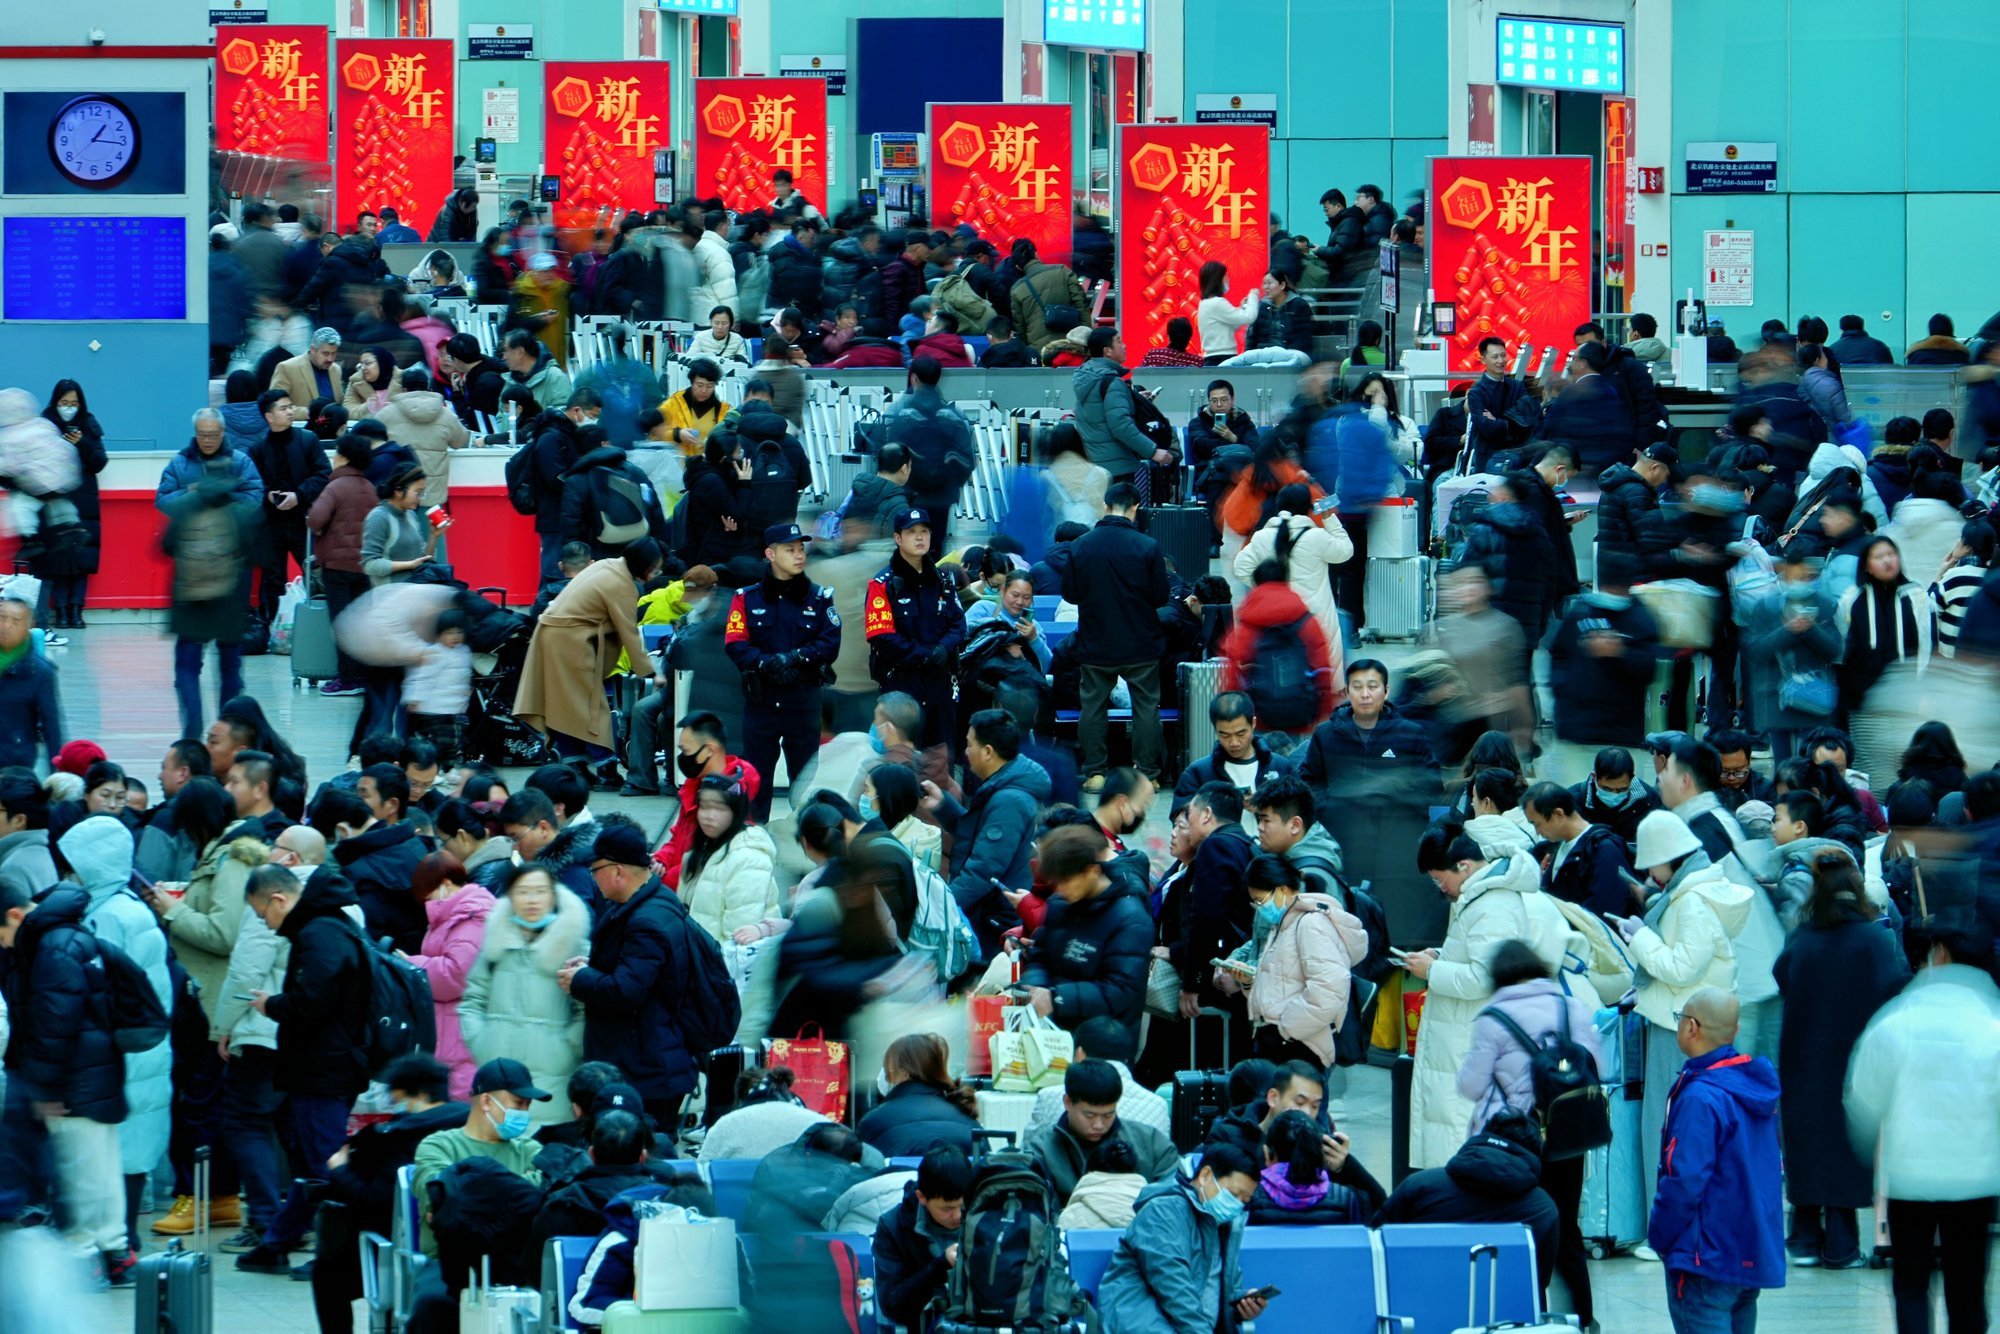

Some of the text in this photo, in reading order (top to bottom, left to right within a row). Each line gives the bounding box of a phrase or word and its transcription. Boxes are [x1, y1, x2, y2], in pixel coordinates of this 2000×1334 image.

[261, 39, 320, 111] 新年
[384, 53, 445, 129] 新年
[88, 106, 102, 116] 12
[105, 110, 112, 119] 1
[595, 76, 660, 157] 新年
[61, 122, 74, 131] 10
[116, 121, 124, 131] 2
[61, 136, 68, 146] 9
[120, 135, 127, 146] 3
[749, 94, 816, 179] 新年
[65, 151, 73, 162] 8
[115, 151, 123, 161] 4
[75, 162, 83, 172] 7
[90, 165, 98, 175] 6
[105, 162, 113, 172] 5
[988, 121, 1062, 214] 新年
[1144, 156, 1165, 179] 福
[1181, 142, 1258, 239] 新年
[1457, 191, 1479, 216] 福
[1496, 177, 1580, 281] 新年
[868, 611, 892, 623] 执勤
[974, 1022, 1000, 1032] KFC
